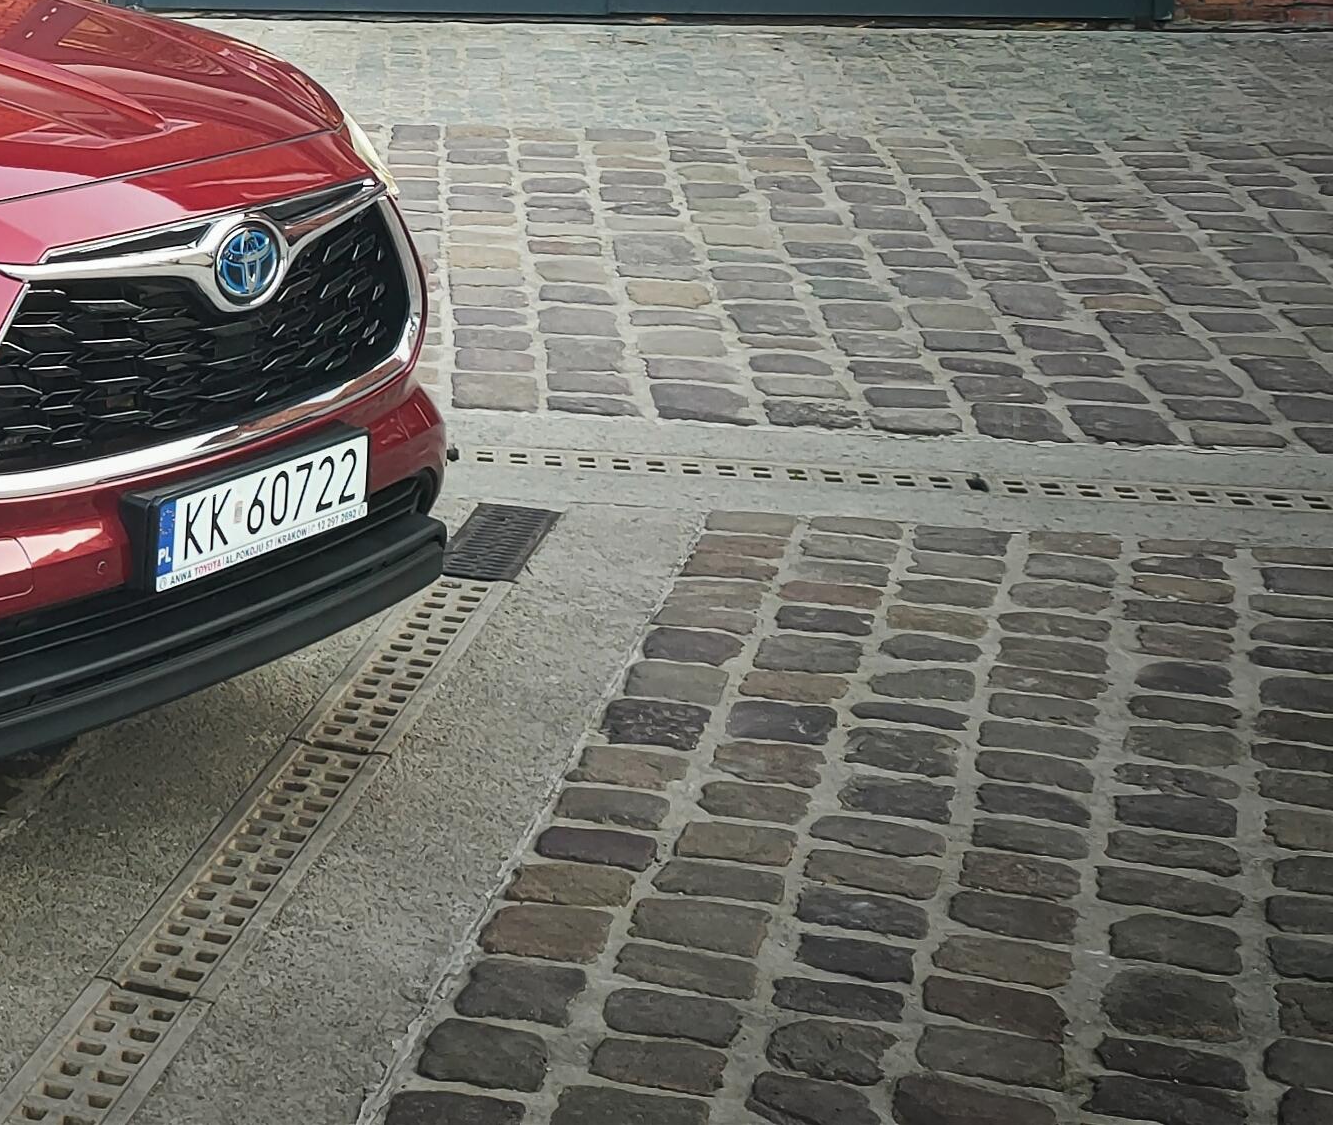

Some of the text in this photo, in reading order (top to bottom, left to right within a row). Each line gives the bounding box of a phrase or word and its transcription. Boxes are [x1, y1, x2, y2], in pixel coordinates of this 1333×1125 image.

[183, 447, 359, 561] KK 60722
[157, 546, 172, 566] PL
[169, 570, 193, 586] ANWA
[194, 559, 222, 577] TOYOTA
